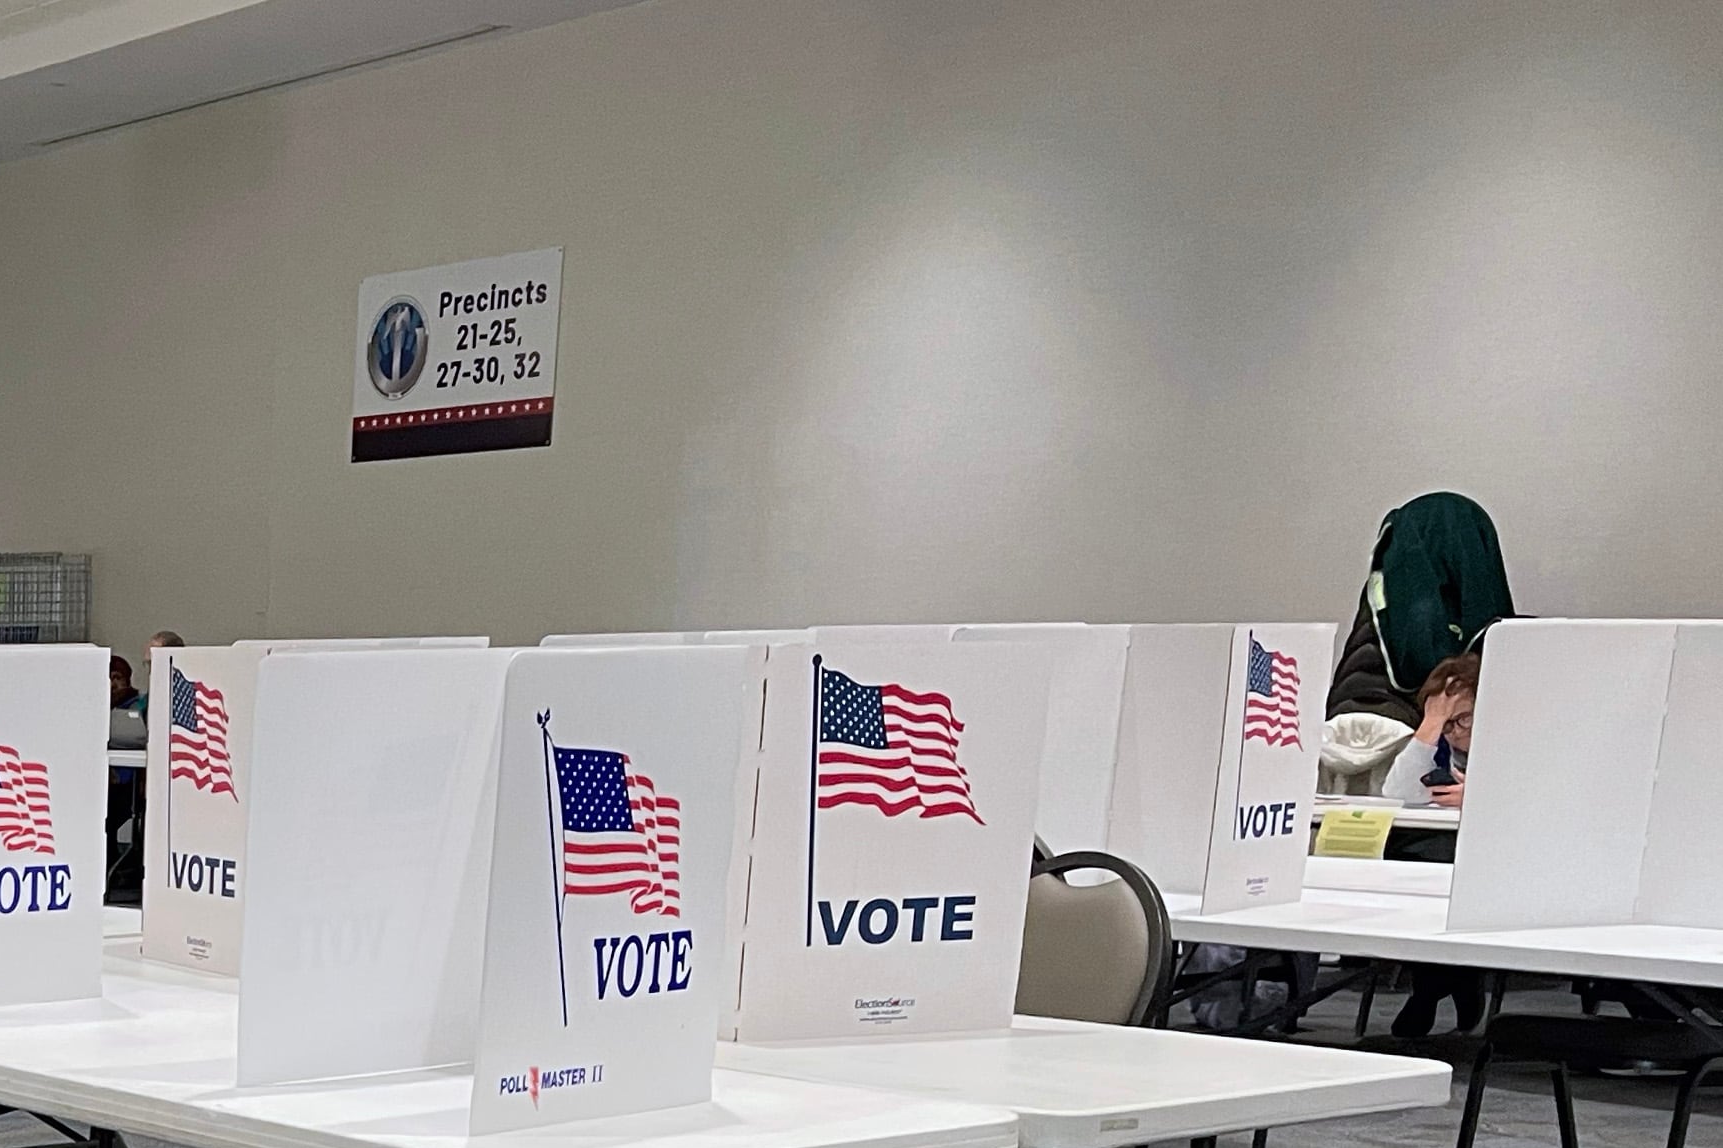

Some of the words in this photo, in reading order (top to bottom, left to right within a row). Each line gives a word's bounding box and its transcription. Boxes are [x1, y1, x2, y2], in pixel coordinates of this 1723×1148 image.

[439, 279, 548, 318] Precincts
[456, 318, 522, 350] 21-25,
[436, 357, 505, 388] 27-30,
[514, 351, 541, 379] 32
[1239, 802, 1296, 840] VOTE
[172, 852, 236, 898] VOTE
[818, 895, 976, 946] VOTE
[593, 930, 693, 1001] VOTE
[500, 1075, 529, 1096] POLL
[541, 1068, 586, 1089] MASTER
[592, 1065, 604, 1083] II
